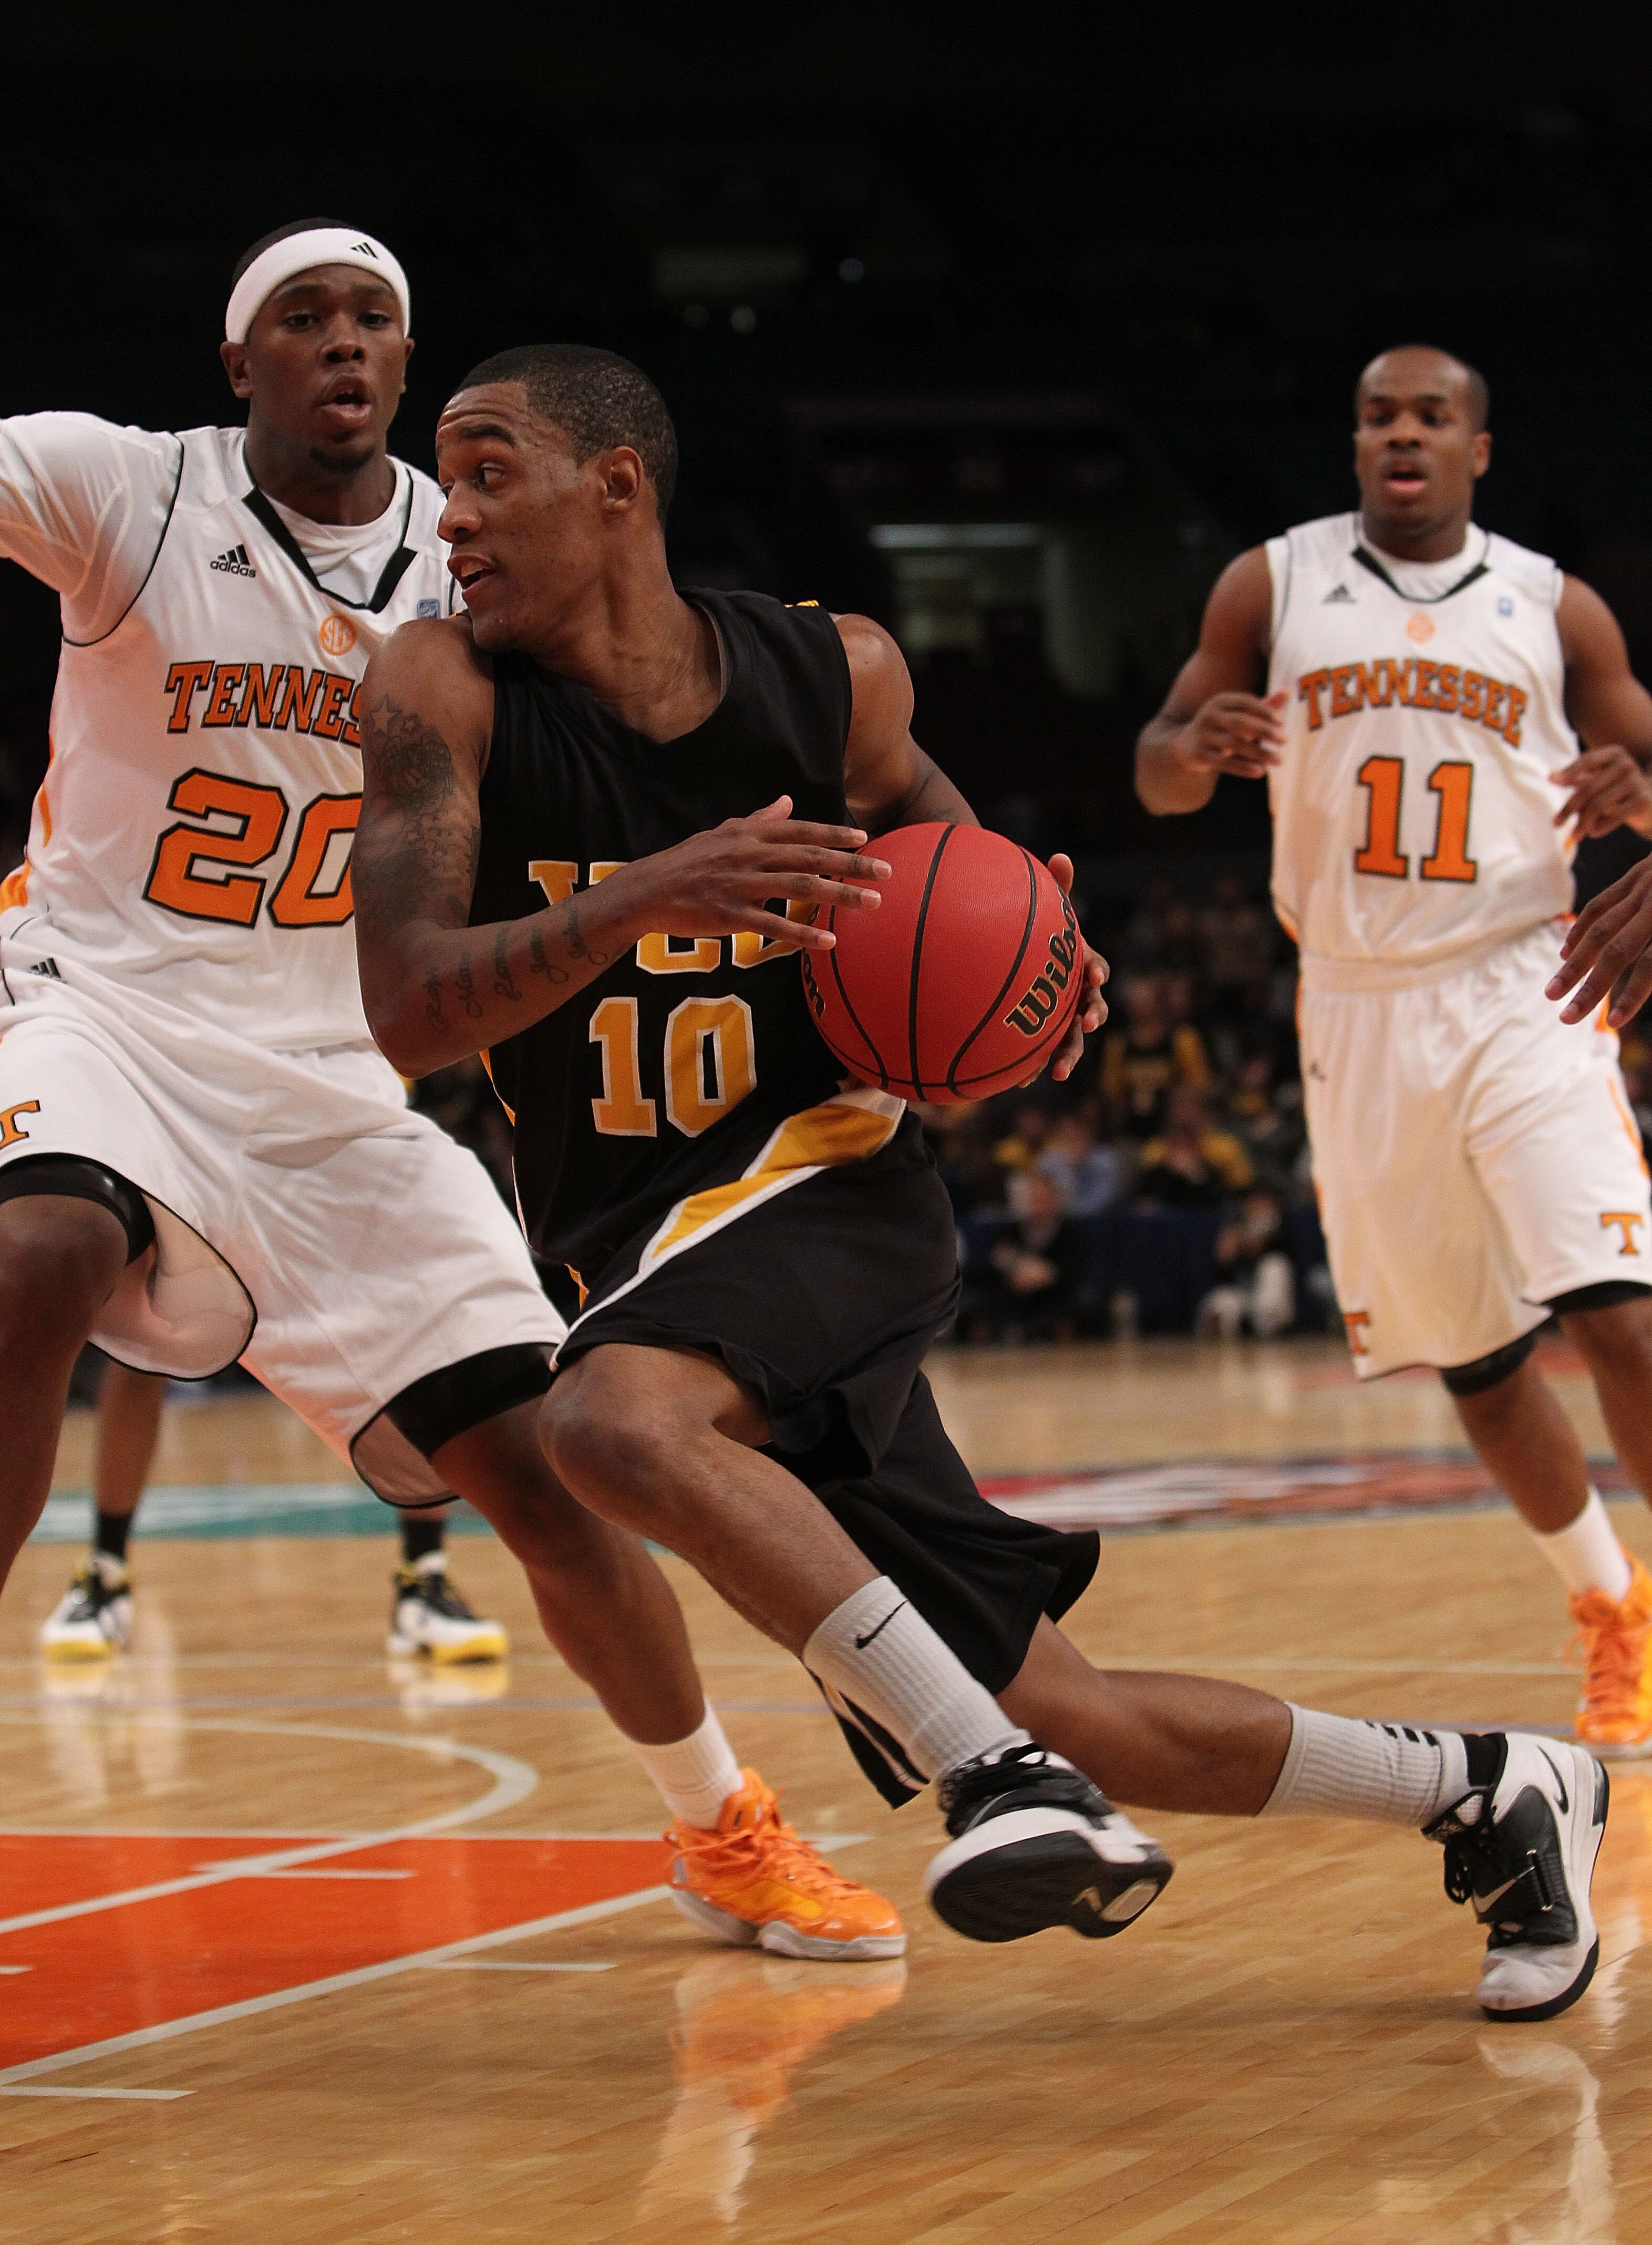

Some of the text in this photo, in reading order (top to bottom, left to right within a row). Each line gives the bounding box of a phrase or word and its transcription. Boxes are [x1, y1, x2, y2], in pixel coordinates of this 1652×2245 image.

[210, 561, 256, 578] adidas
[1298, 658, 1527, 749] TENNESSEE
[142, 767, 363, 930] 20
[1354, 755, 1478, 883] 11
[1003, 879, 1077, 1039] Wilso
[588, 993, 758, 1138] 10
[1600, 1211, 1644, 1256] T
